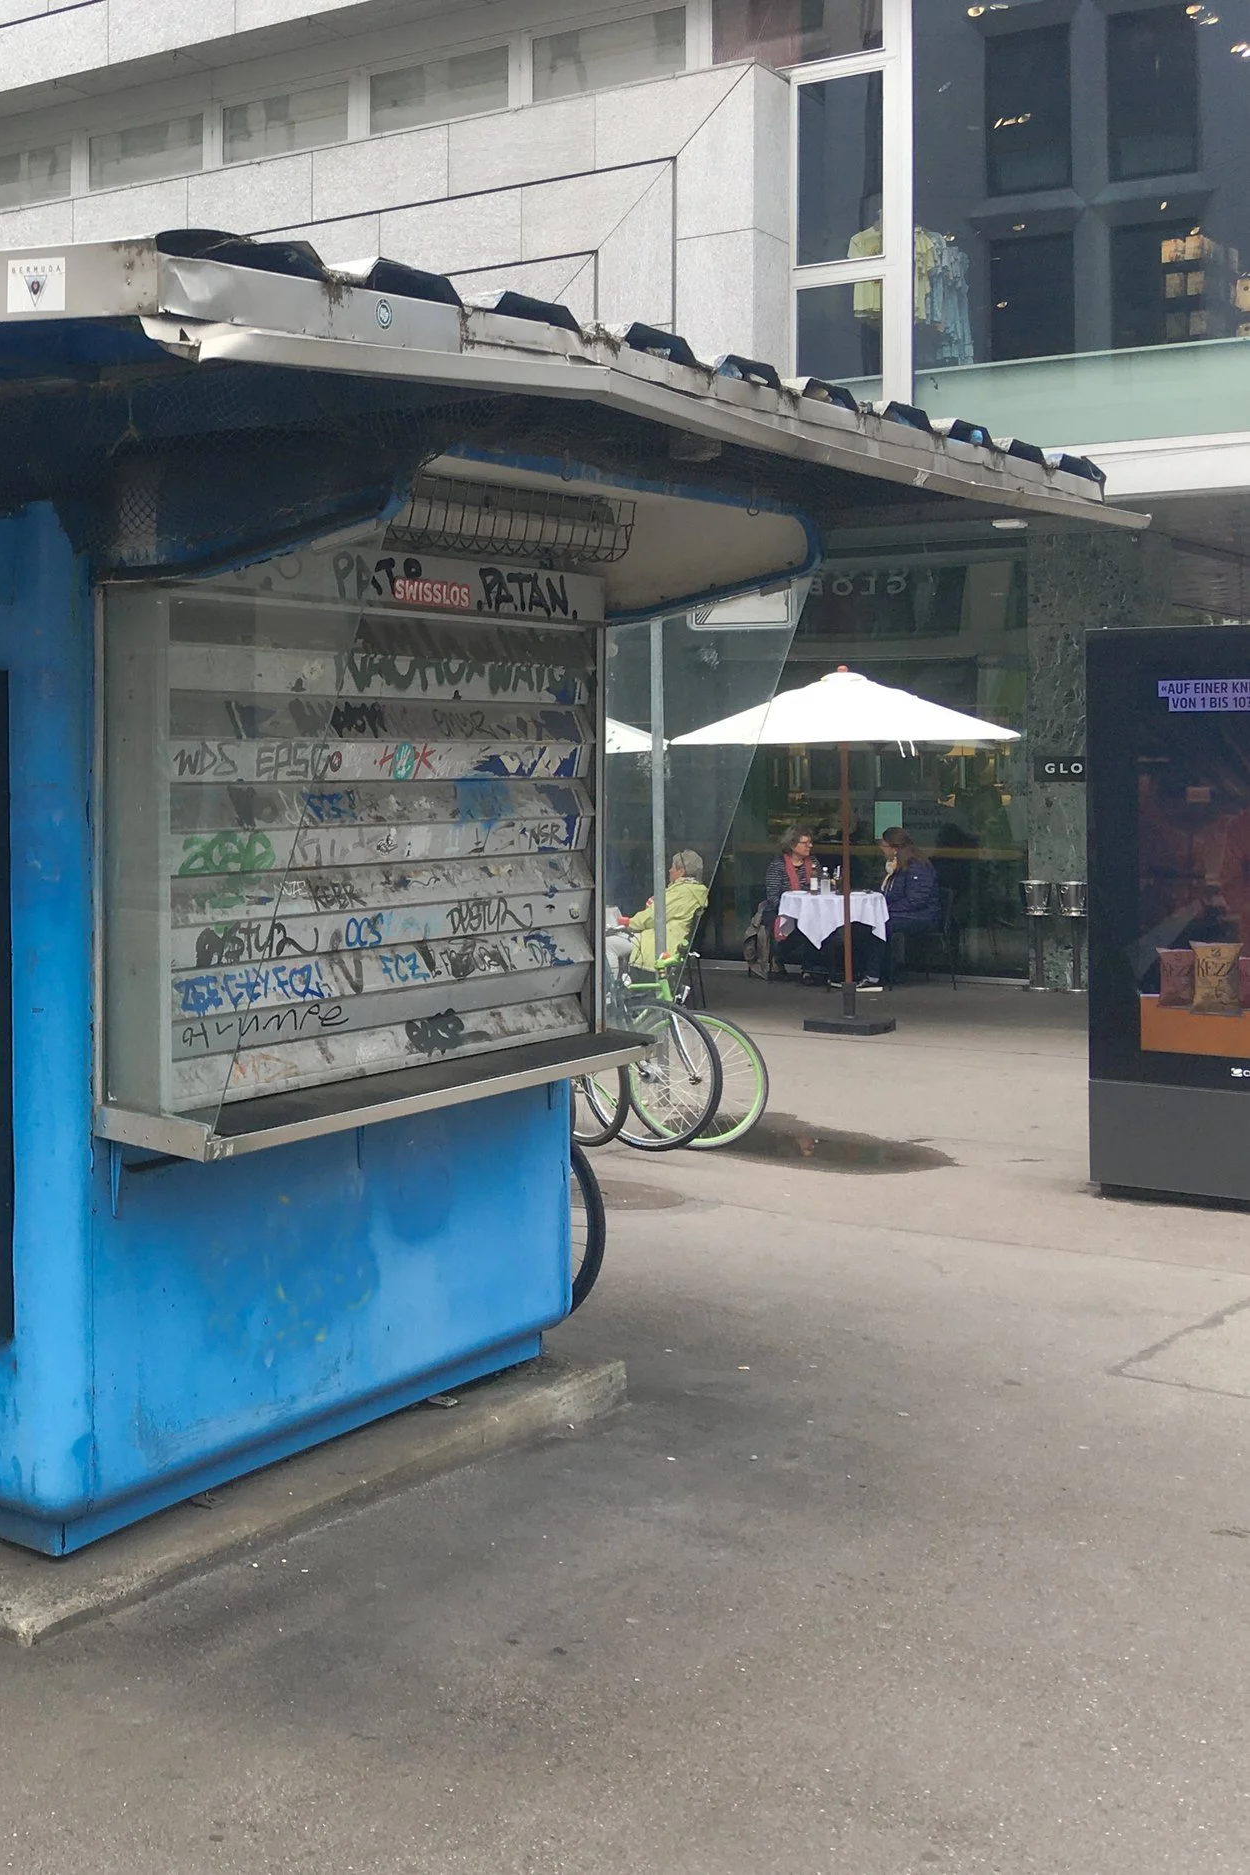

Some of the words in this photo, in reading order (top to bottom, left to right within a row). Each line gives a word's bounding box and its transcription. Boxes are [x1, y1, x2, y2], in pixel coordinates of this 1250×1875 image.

[11, 264, 61, 274] BERMUDA
[393, 578, 472, 608] SWISSLOS
[1194, 681, 1228, 694] EINER
[1172, 697, 1197, 709] VON
[1200, 697, 1207, 709] 1
[1210, 697, 1229, 709] BIS
[1044, 763, 1083, 775] GLO
